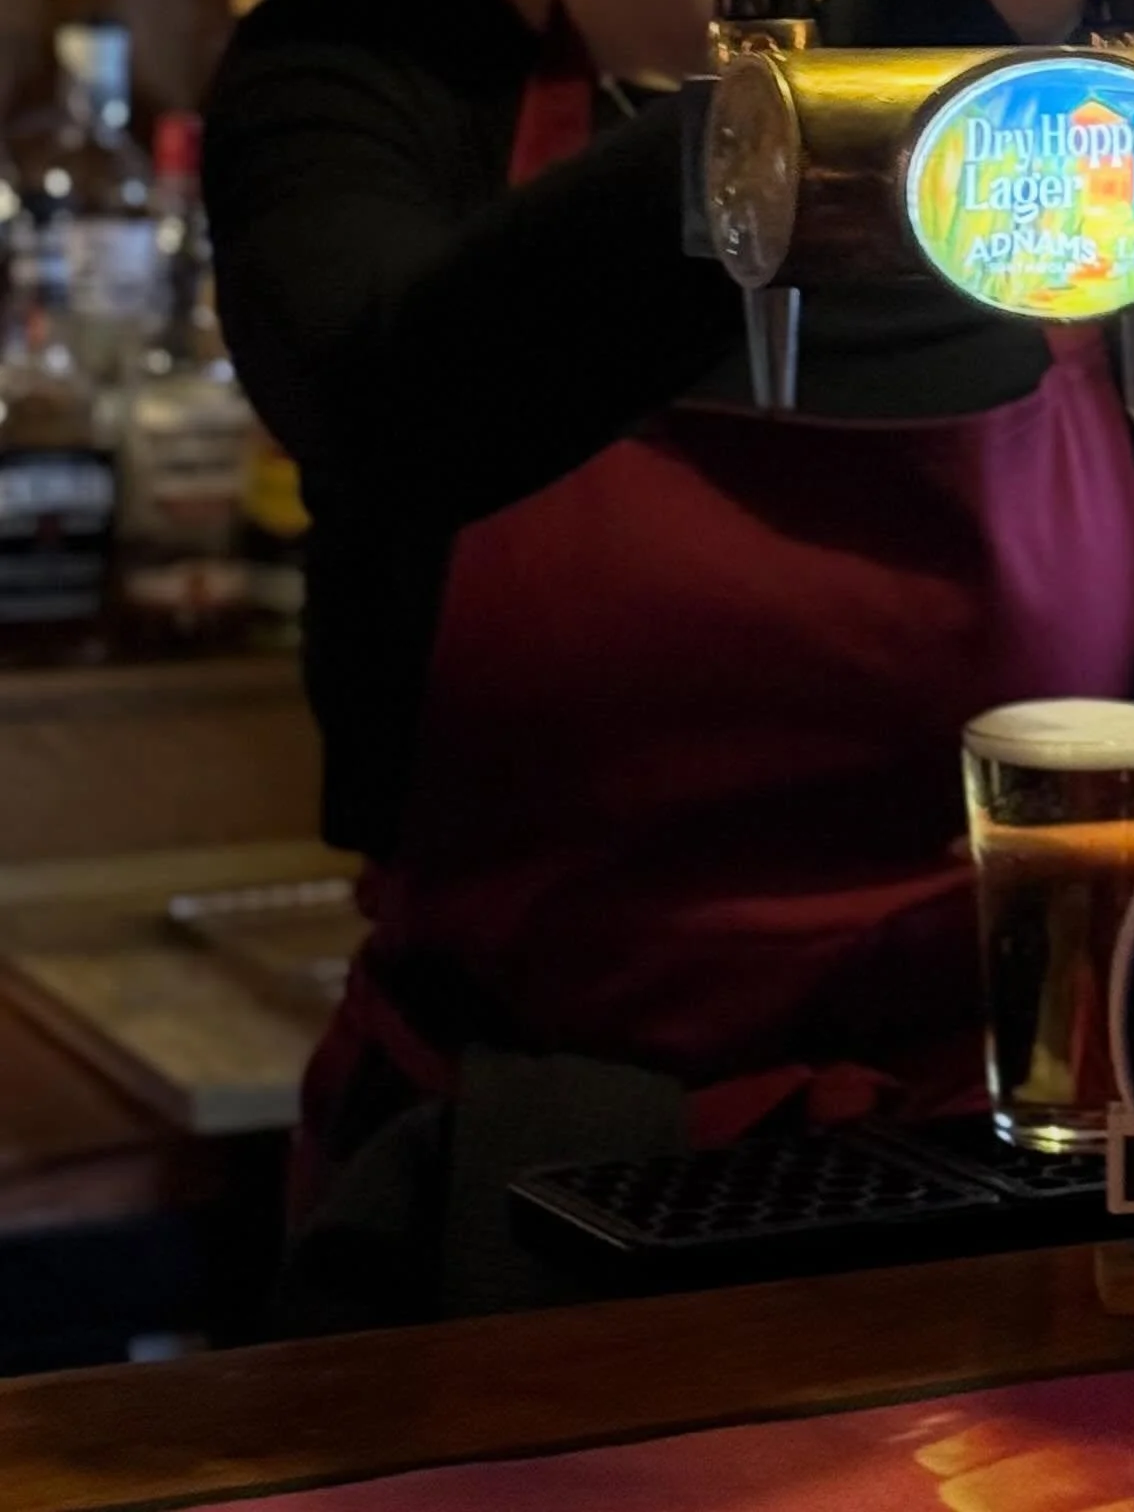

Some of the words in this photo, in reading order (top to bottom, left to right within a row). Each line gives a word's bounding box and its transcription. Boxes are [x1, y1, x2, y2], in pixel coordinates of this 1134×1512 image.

[967, 116, 1034, 169] Dry
[964, 165, 1083, 224] Lager
[964, 229, 1097, 267] ADNAMS
